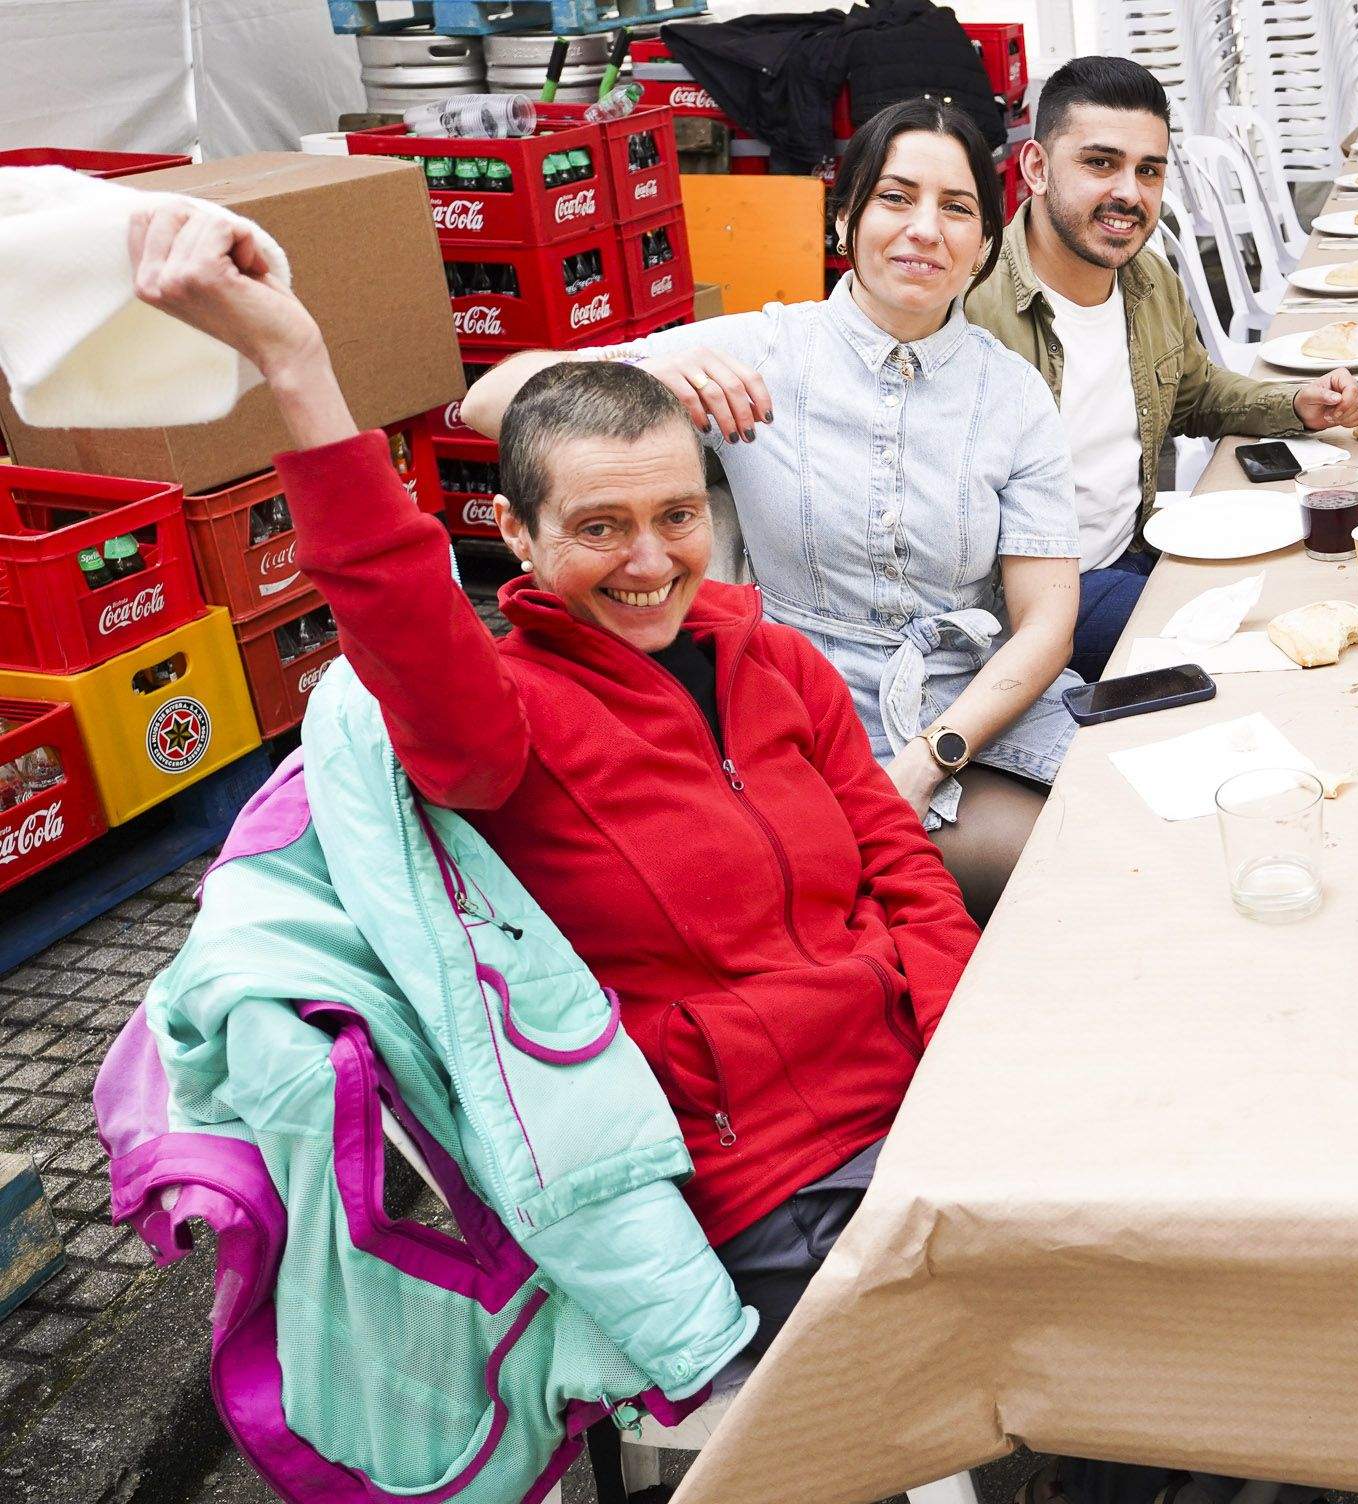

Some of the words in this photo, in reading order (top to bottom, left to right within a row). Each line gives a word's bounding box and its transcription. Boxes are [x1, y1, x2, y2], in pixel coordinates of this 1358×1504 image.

[432, 200, 484, 229] a-Cola
[555, 189, 596, 223] Coca-Cola
[453, 306, 502, 335] a-Cola
[571, 293, 611, 329] Coca-Cola
[260, 540, 297, 575] Coca-C
[99, 582, 165, 635] Coca-Cola
[0, 799, 65, 865] a-Cola
